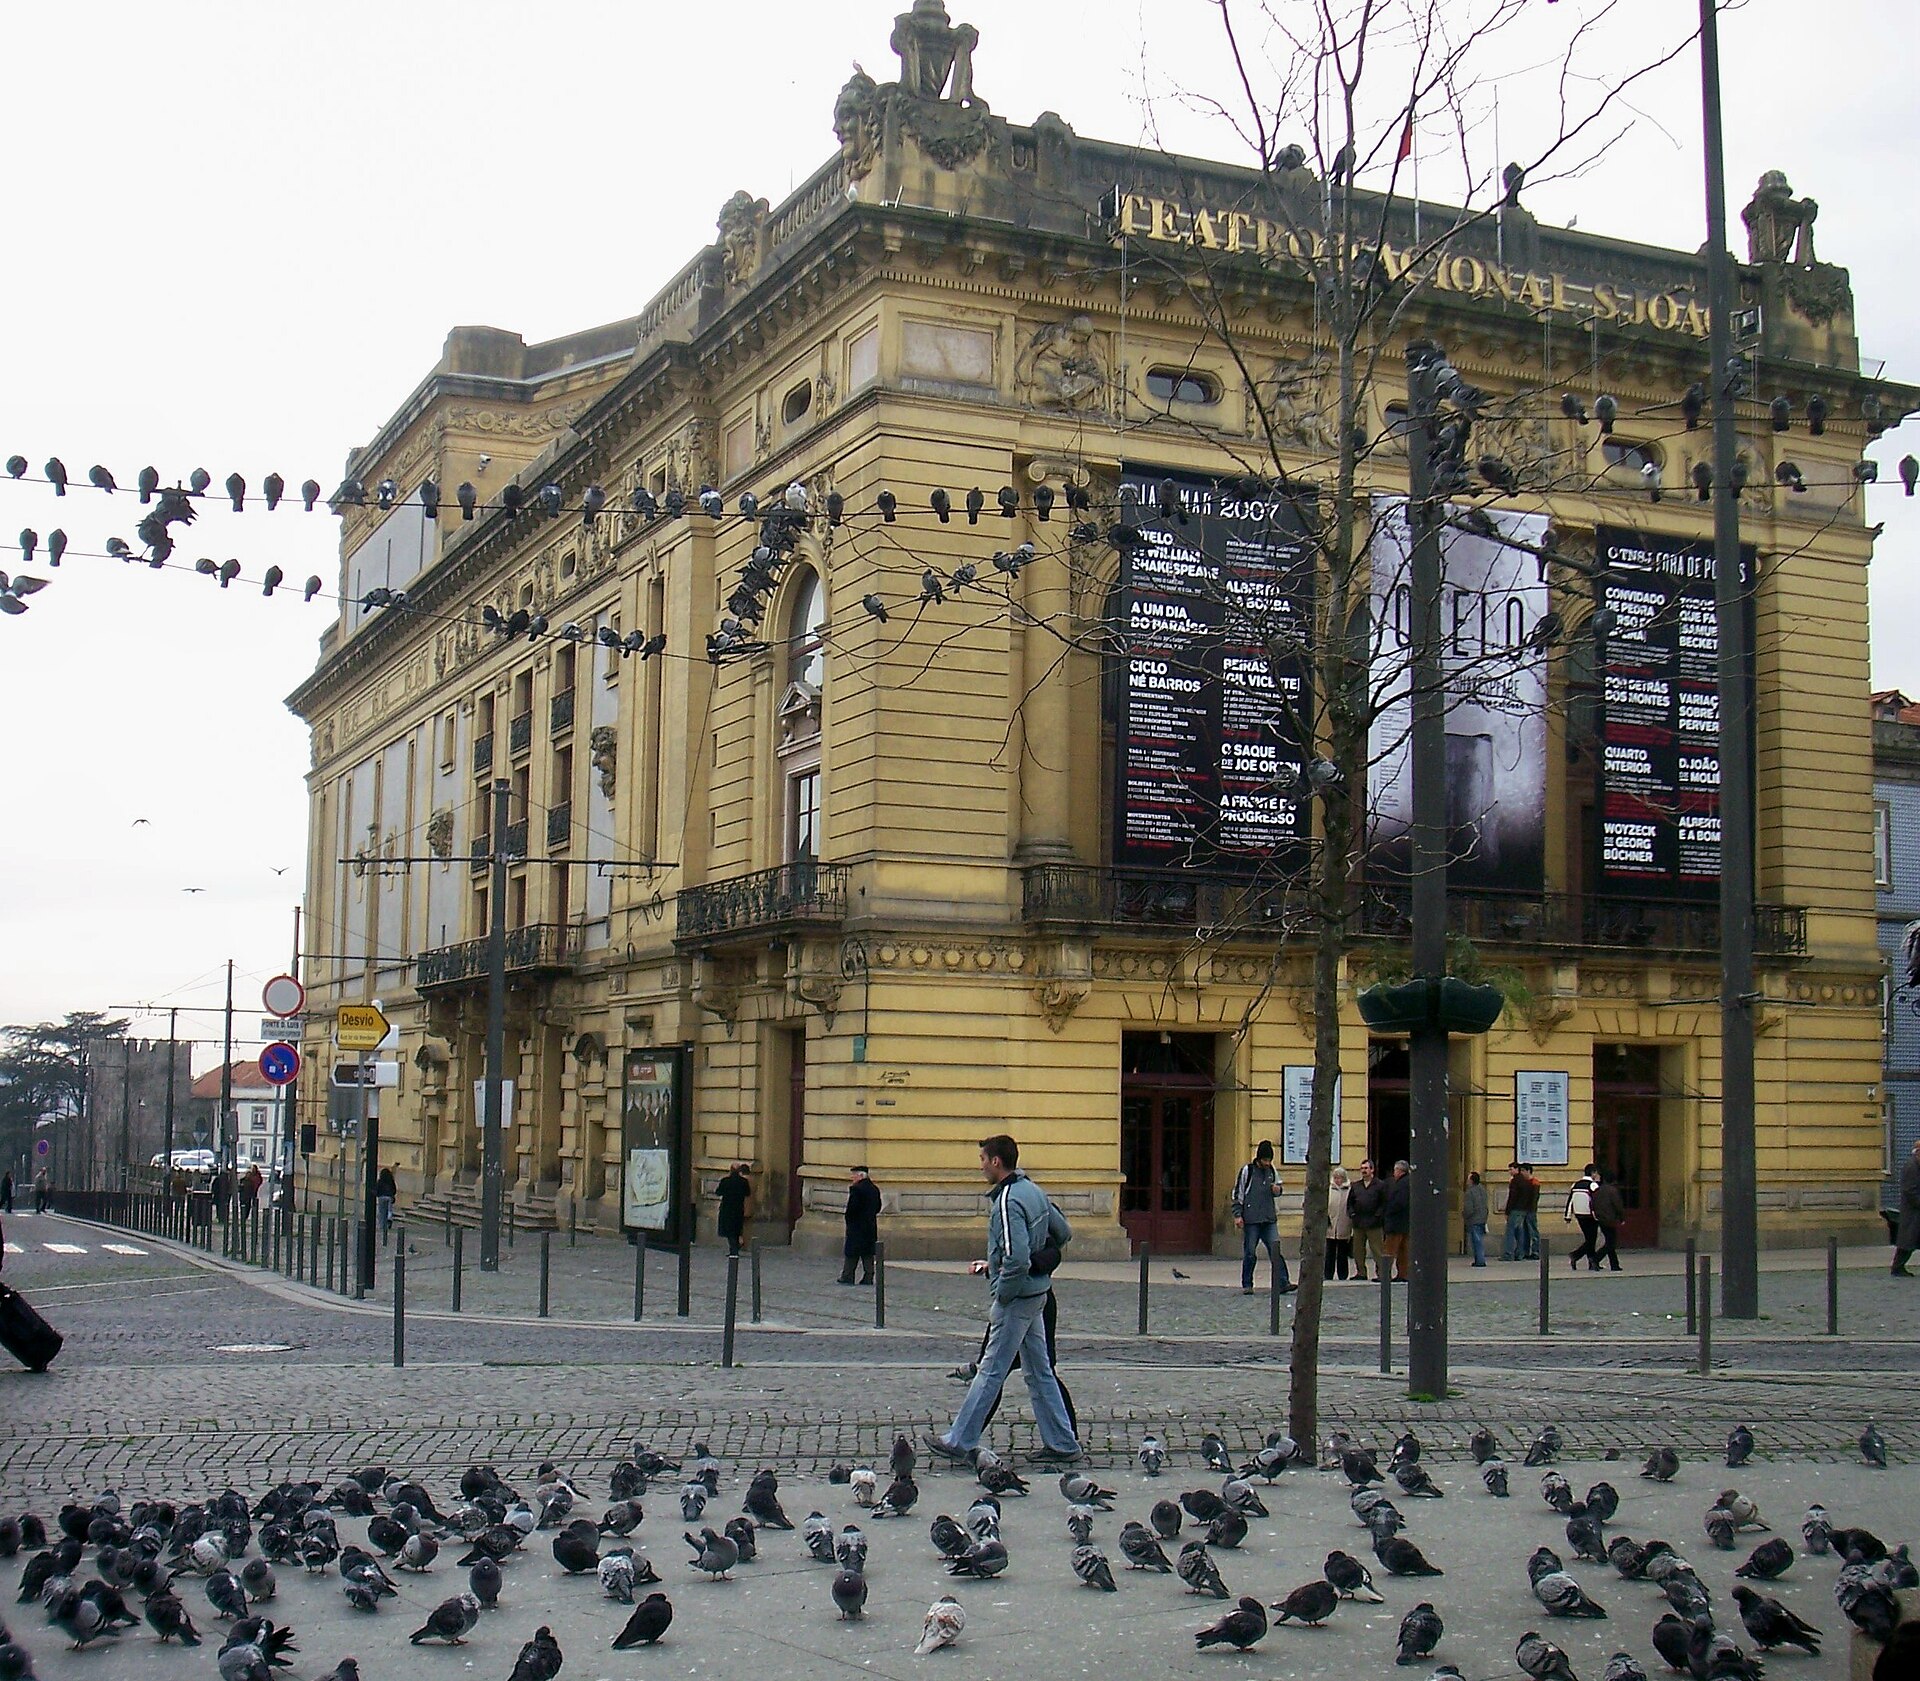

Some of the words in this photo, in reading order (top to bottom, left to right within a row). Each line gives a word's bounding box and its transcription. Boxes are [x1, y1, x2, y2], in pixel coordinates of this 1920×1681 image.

[1120, 194, 1330, 266] TEATRO
[1219, 498, 1279, 522] 2007
[1687, 557, 1702, 578] DE
[1605, 587, 1665, 606] CONVIDADO
[1131, 601, 1140, 614] A
[1143, 602, 1163, 617] UM
[1165, 605, 1187, 620] DIA
[1606, 602, 1619, 612] DE
[1621, 603, 1655, 616] PEDRA
[1679, 611, 1701, 621] QUE
[1130, 616, 1150, 630] DO
[1129, 659, 1168, 675] CICLO
[1129, 674, 1147, 689] NÉ
[1149, 676, 1201, 694] BARROS
[1628, 679, 1668, 693] DETRÁS
[1605, 690, 1627, 701] DOS
[1628, 692, 1670, 707] MONTES
[1679, 706, 1710, 717] SOBRE
[1222, 744, 1232, 756] O
[1233, 744, 1276, 759] SAQUE
[1605, 747, 1647, 760] QUARTO
[1221, 758, 1233, 769] DE
[1235, 759, 1257, 772] JOE
[1605, 760, 1651, 773] INTERIOR
[1679, 757, 1719, 771] D.JOÃO
[1679, 772, 1689, 782] DE
[1220, 795, 1232, 807] A
[1604, 823, 1656, 837] WOYZECK
[1679, 830, 1686, 840] E
[1687, 830, 1695, 840] A
[1604, 837, 1614, 846] DE
[1615, 837, 1651, 849] GEORG
[1604, 848, 1653, 862] BÜCHNER
[342, 1013, 374, 1026] Desvio
[1288, 1096, 1296, 1119] 2007
